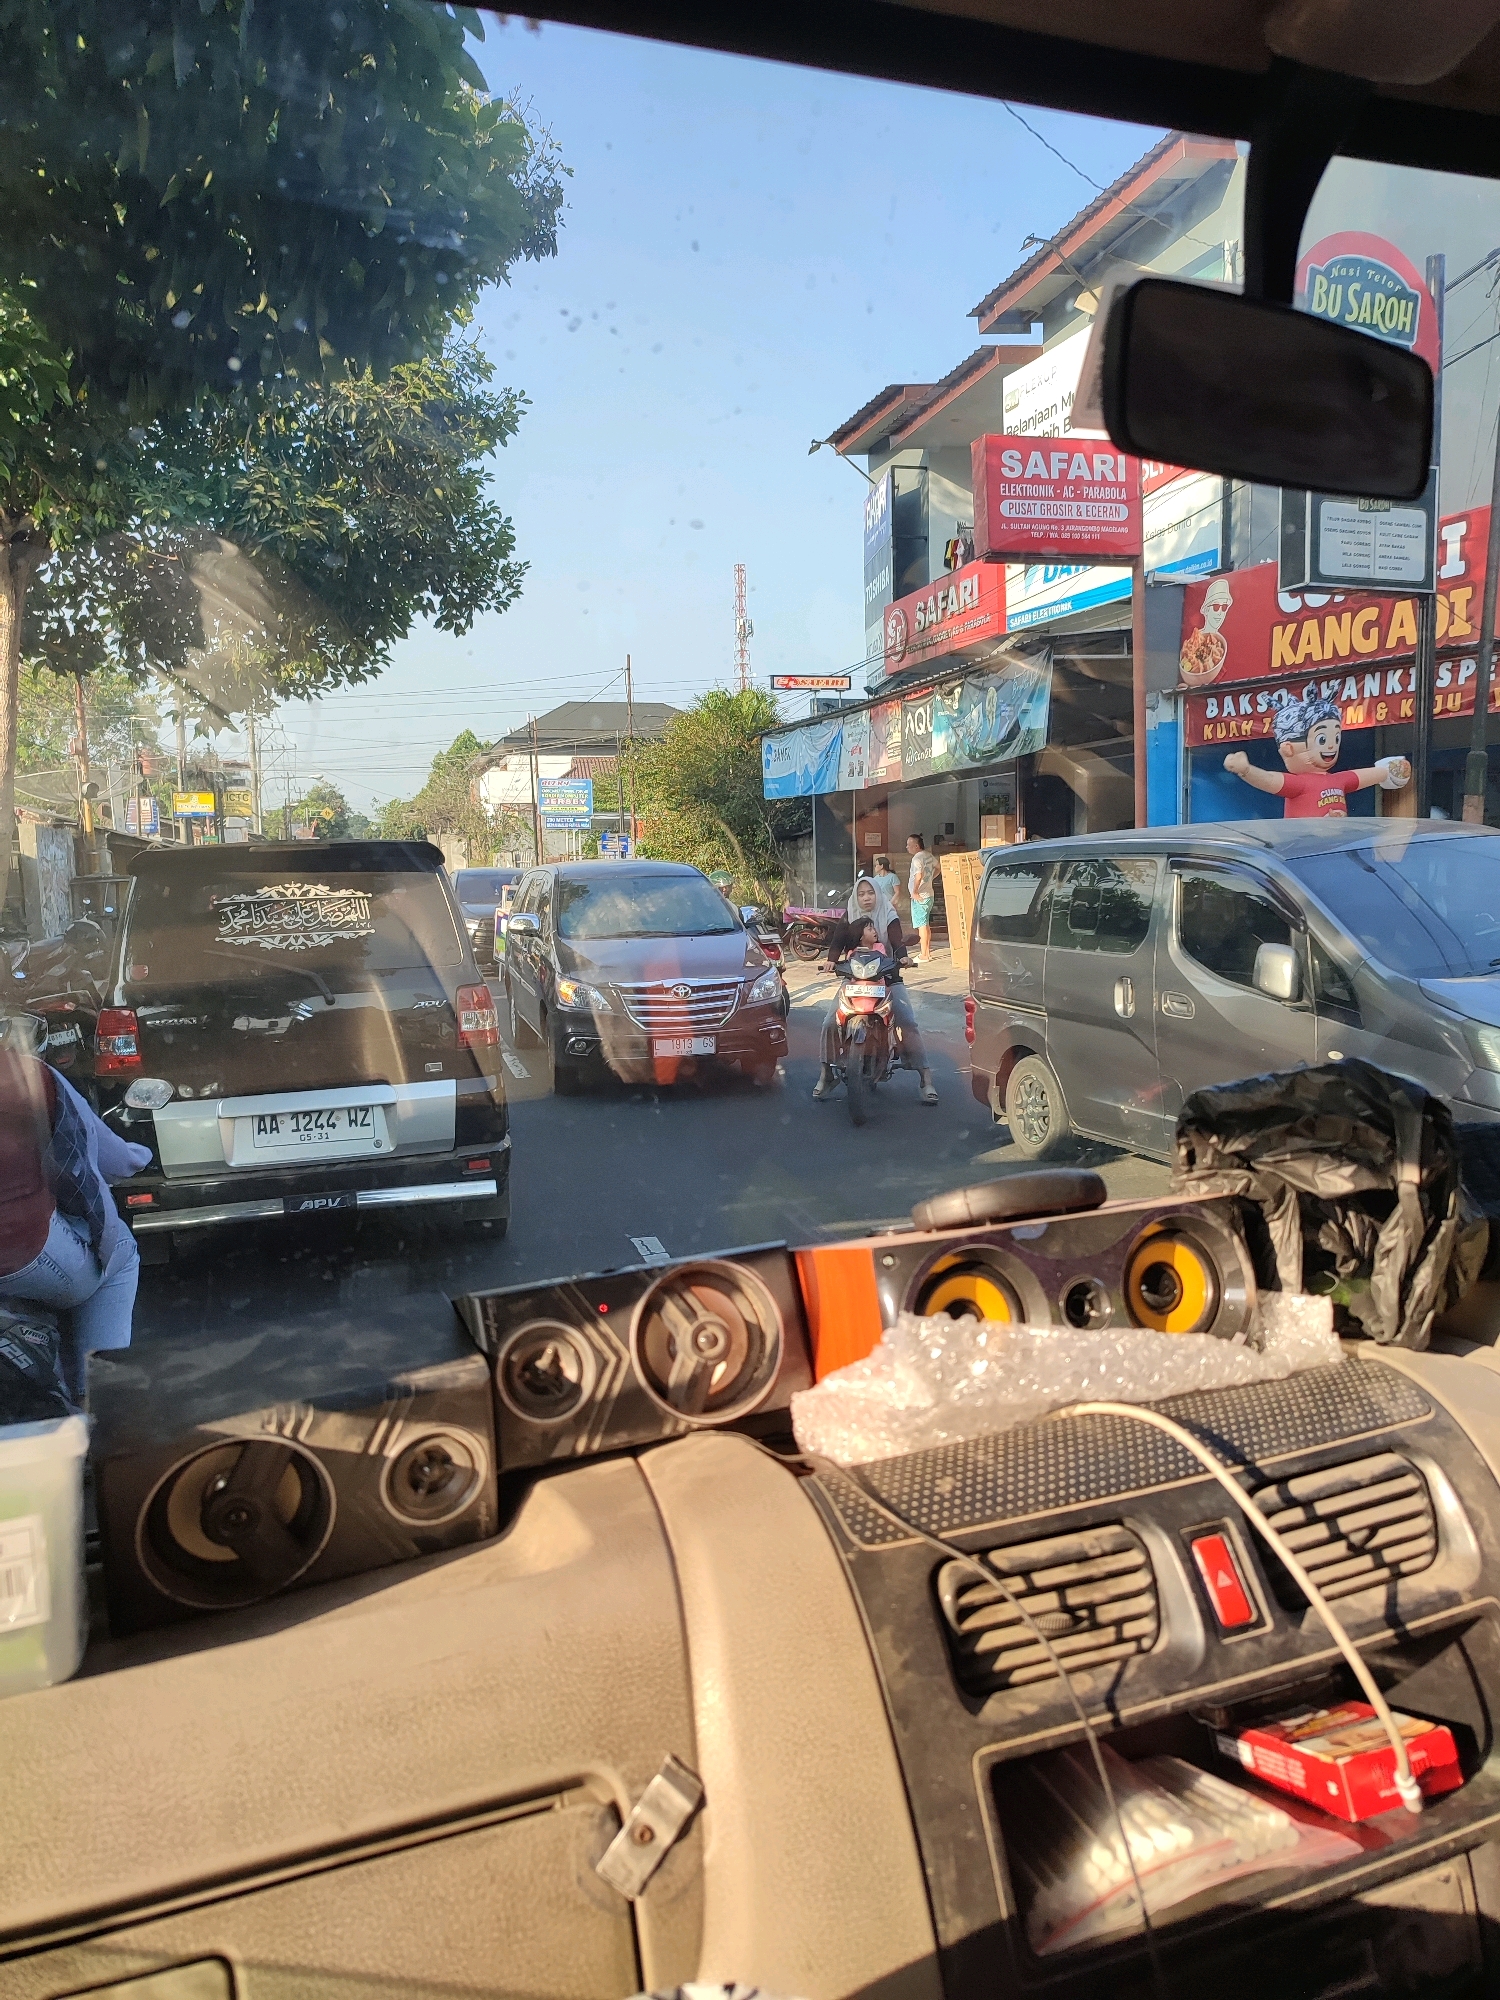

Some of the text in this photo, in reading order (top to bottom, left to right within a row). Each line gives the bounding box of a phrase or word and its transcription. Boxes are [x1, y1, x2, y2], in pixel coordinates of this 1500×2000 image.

[1330, 265, 1401, 292] Nasi Telor
[1312, 275, 1414, 333] BU SAROH
[1007, 403, 1058, 436] Belanjaan
[1001, 450, 1126, 482] SAFARI
[1000, 483, 1054, 498] ELEKTRONIK
[1063, 485, 1075, 499] AC
[1083, 486, 1127, 500] PARABOLA
[1008, 502, 1120, 518] PUSAT GROSIR & ECERAN
[865, 565, 890, 606] TOSHIBA
[914, 573, 980, 633] SAFARI
[1009, 612, 1032, 628] SAFARI
[1271, 607, 1380, 668] KANG
[1203, 719, 1254, 741] KUAH
[1375, 702, 1389, 721] &
[1400, 693, 1462, 718] KJU
[1205, 688, 1289, 719] BAKSO
[226, 793, 249, 802] ICTC
[655, 1037, 715, 1051] L 1913 GS
[257, 1108, 371, 1136] AA 1244 WZ
[299, 1197, 342, 1211] APV
